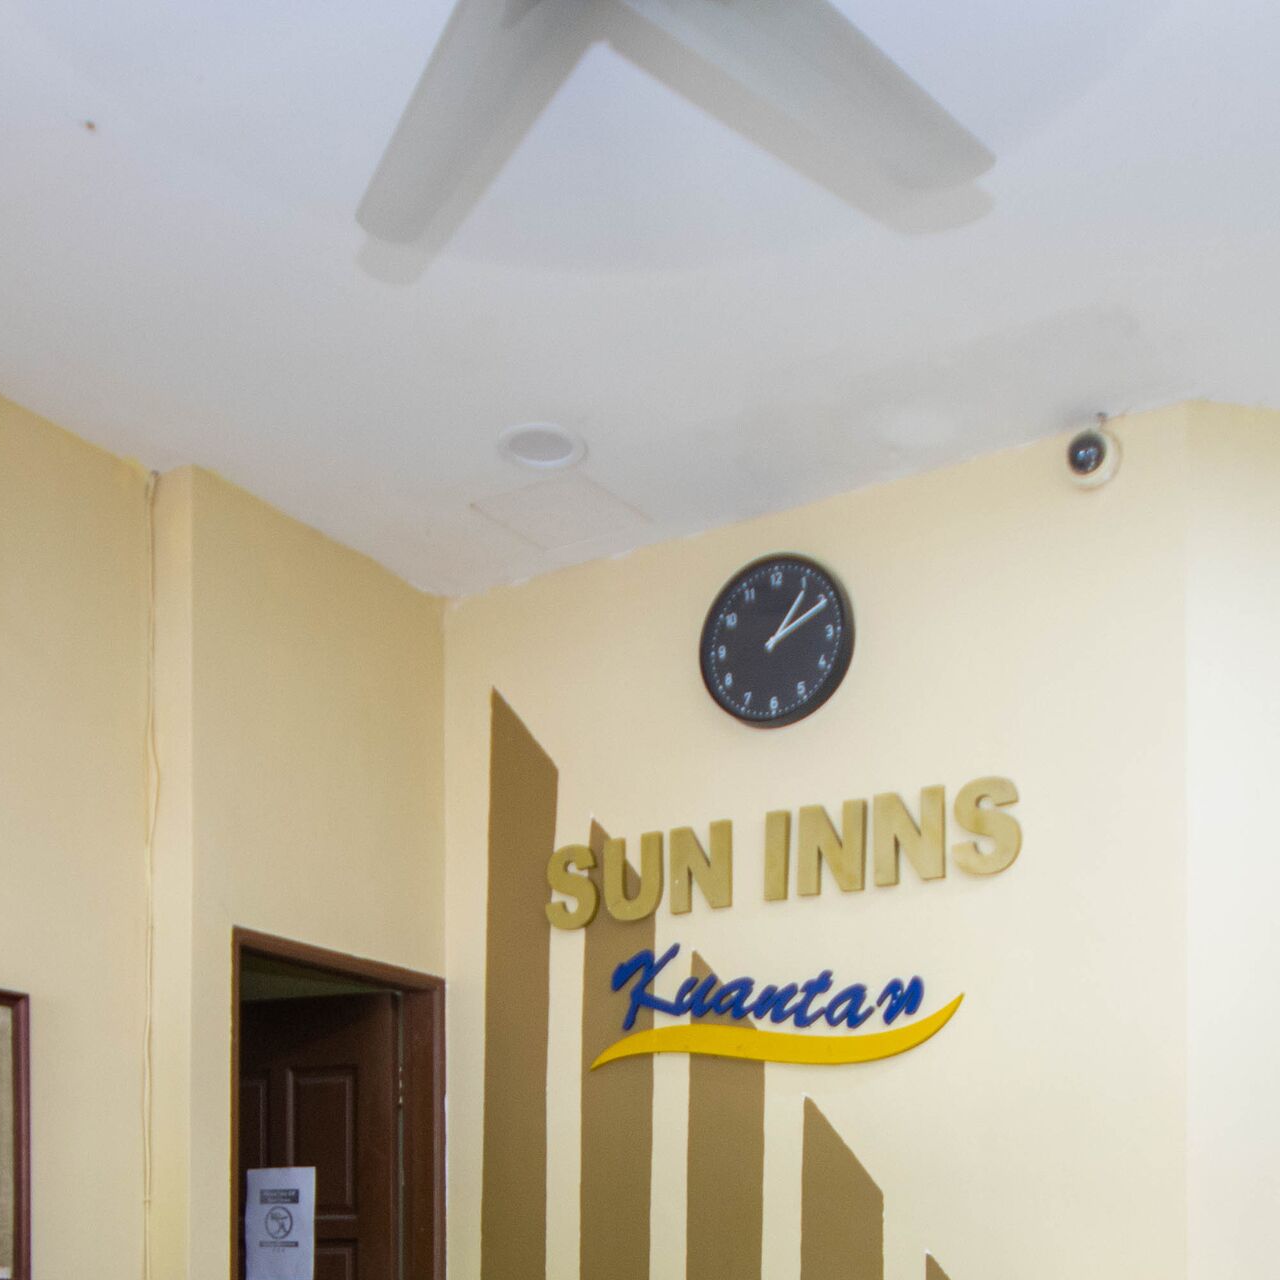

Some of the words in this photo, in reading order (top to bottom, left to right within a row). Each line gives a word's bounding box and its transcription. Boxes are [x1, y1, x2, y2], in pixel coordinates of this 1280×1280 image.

[770, 571, 783, 587] 12
[744, 588, 755, 602] 11
[726, 612, 737, 628] 10
[825, 624, 834, 639] 3
[718, 645, 726, 661] 9
[818, 654, 826, 668] 4
[725, 672, 733, 687] 8
[796, 681, 805, 695] 5
[744, 691, 752, 705] 7
[770, 696, 778, 710] 6
[545, 819, 733, 930] SUN
[763, 776, 1022, 900] INNS
[610, 943, 924, 1031] Kuantan
